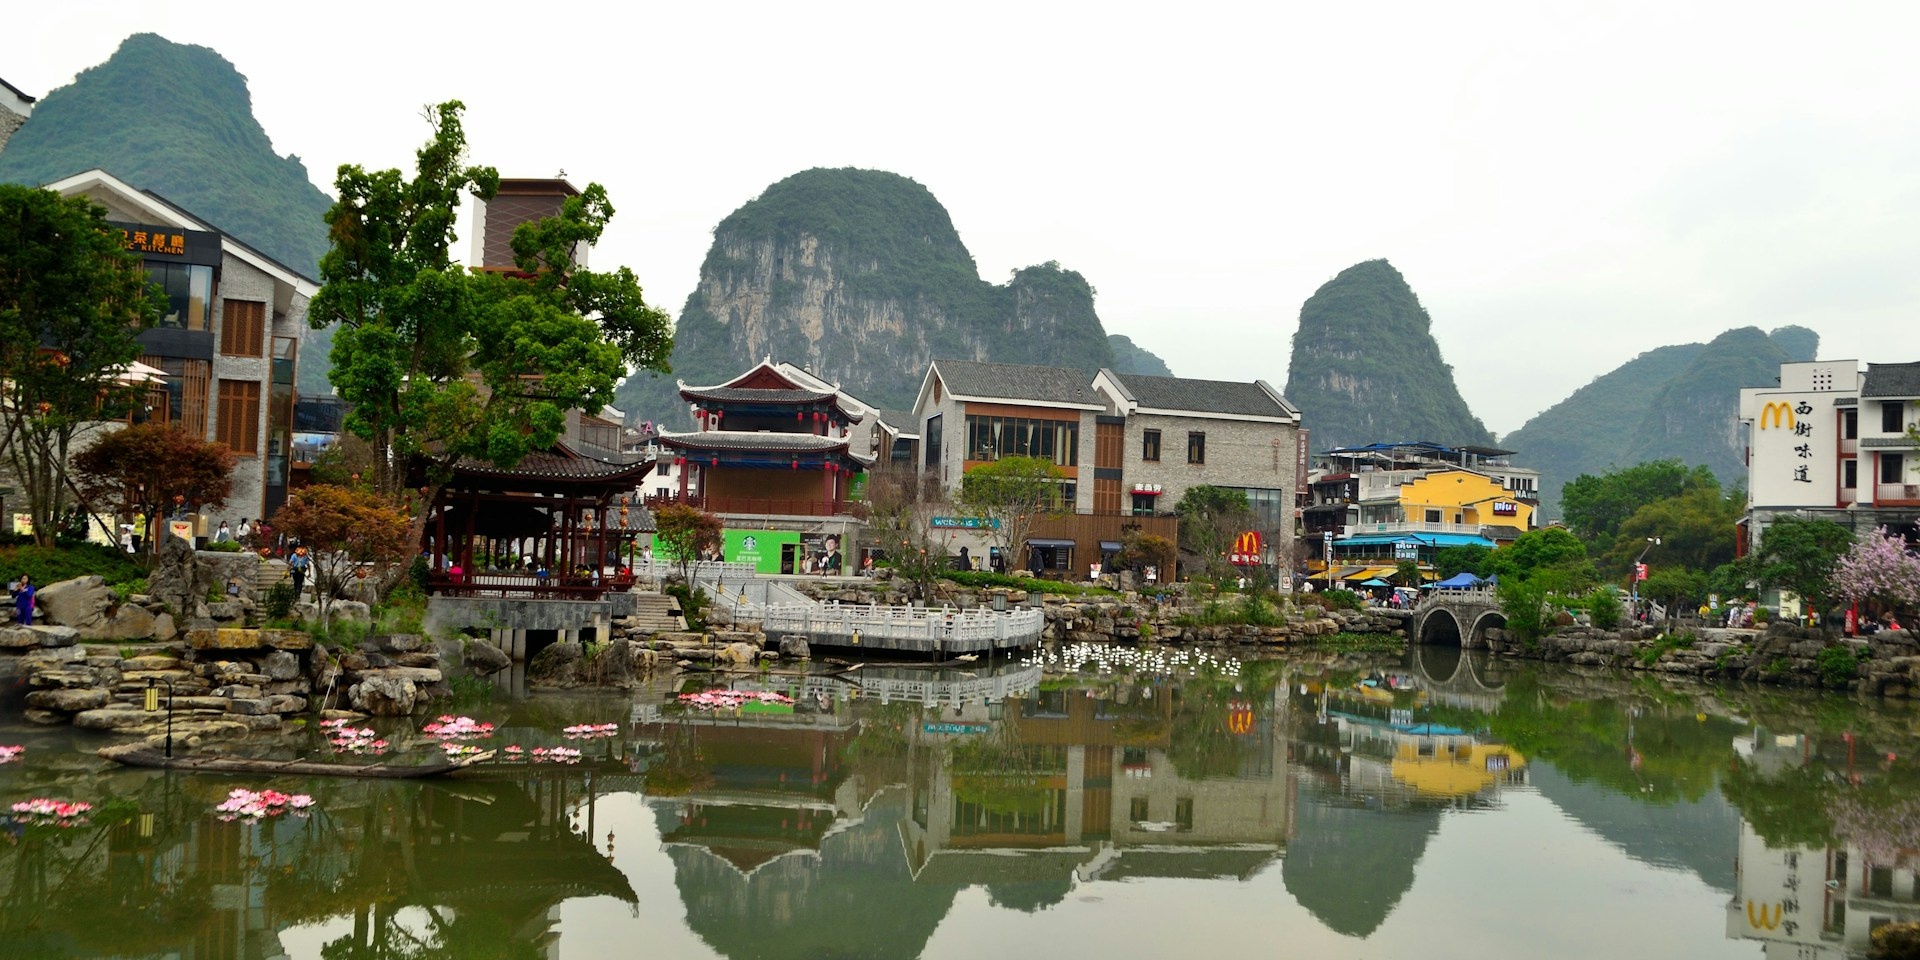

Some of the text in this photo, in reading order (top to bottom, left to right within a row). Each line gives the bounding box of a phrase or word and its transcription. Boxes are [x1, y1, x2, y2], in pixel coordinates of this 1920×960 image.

[141, 245, 184, 255] KITCHEN
[1794, 401, 1813, 483] 西街味道
